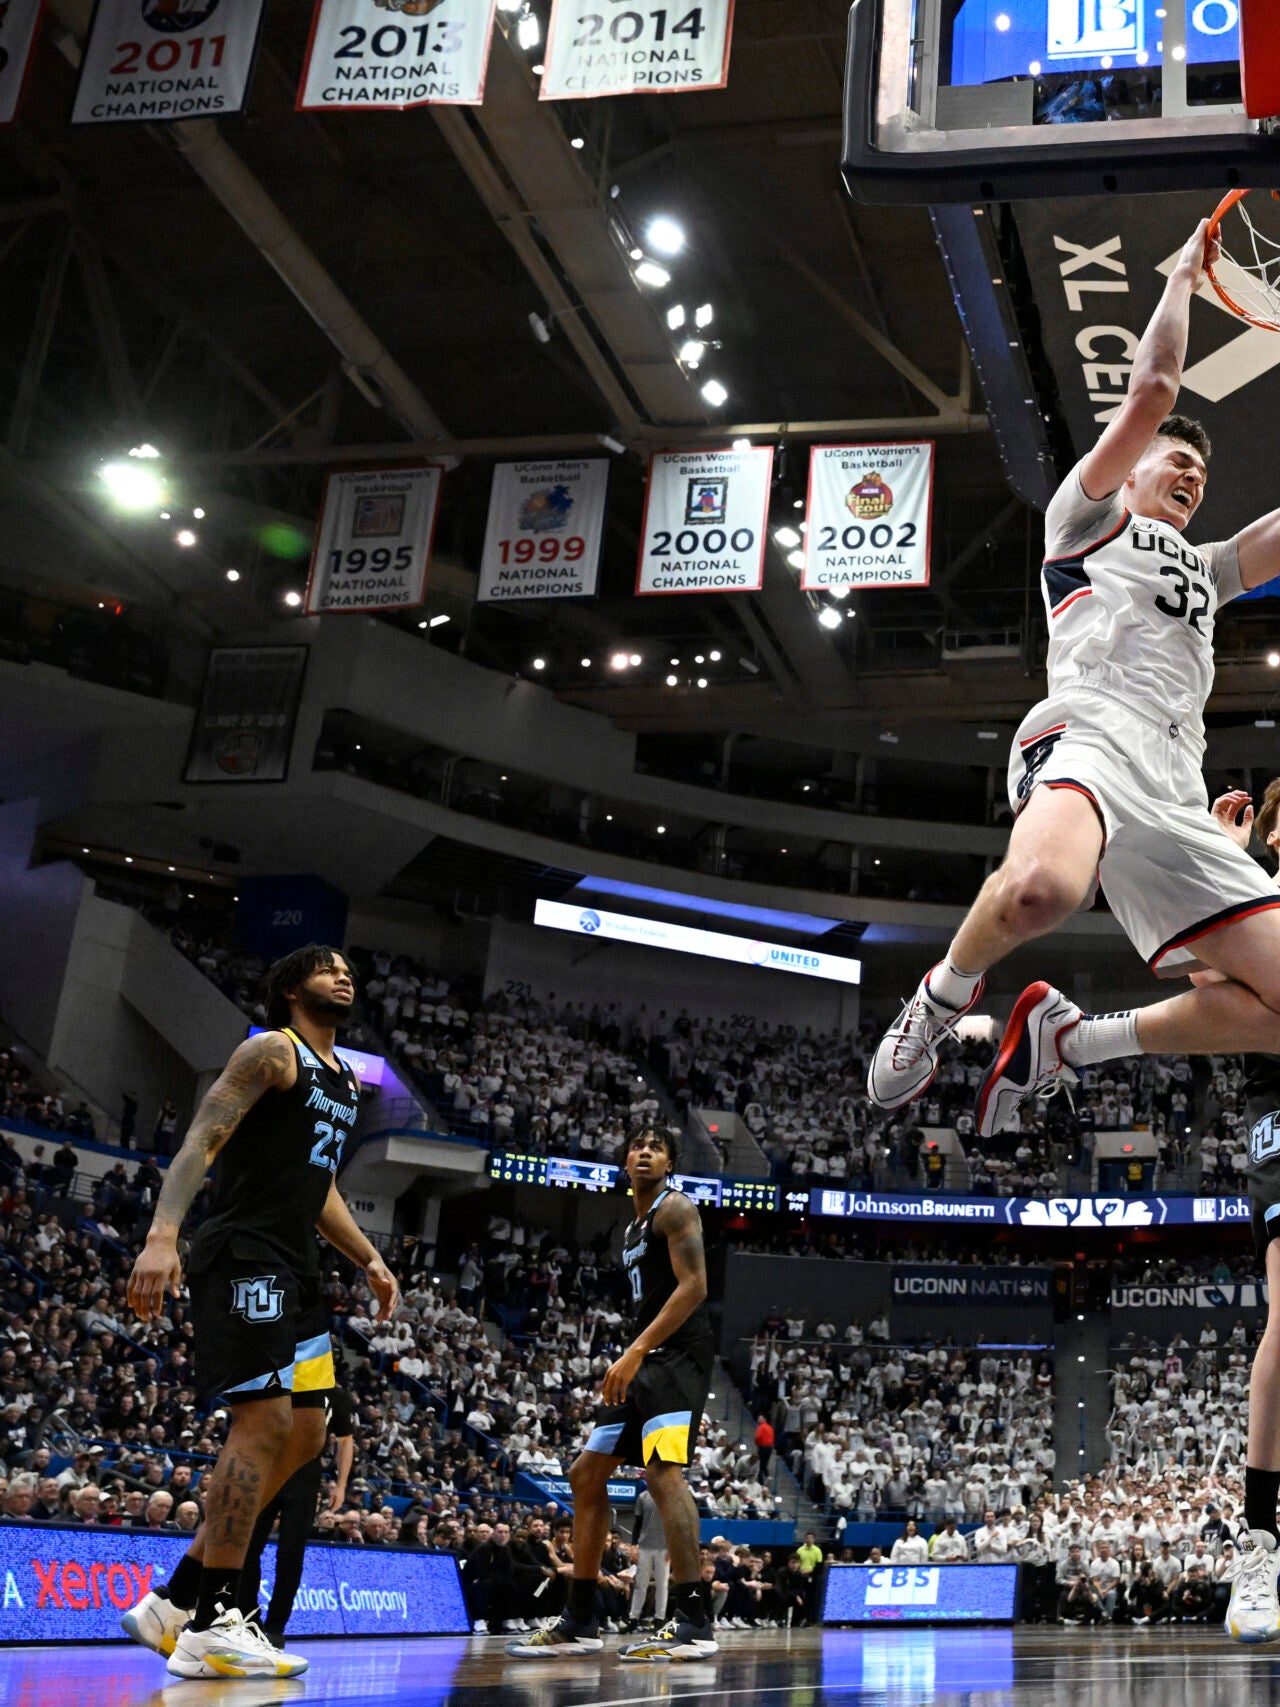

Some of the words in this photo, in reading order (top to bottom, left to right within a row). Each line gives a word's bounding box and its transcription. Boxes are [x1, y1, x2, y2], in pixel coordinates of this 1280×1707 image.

[573, 8, 705, 47] 2014
[333, 22, 466, 59] 2013
[109, 35, 226, 75] 2011
[578, 48, 696, 67] NATIONAL
[335, 62, 452, 80] NATIONAL
[105, 76, 219, 96] NATIONAL
[322, 82, 460, 101] CHAMPIONS
[91, 95, 225, 118] CHAMPIONS
[1053, 235, 1129, 311] XL
[1075, 325, 1137, 422] CEN
[663, 454, 702, 463] UConn
[824, 449, 863, 458] UConn
[867, 446, 921, 457] Women's
[514, 463, 553, 472] UConn
[556, 461, 589, 470] Men's
[680, 465, 741, 475] Basketball
[841, 459, 902, 469] Basketball
[520, 473, 581, 484] Basketball
[846, 493, 885, 505] Final
[650, 528, 754, 556] 2000
[817, 522, 917, 551] 2002
[498, 536, 585, 565] 1999
[330, 546, 414, 574] 1995
[661, 559, 741, 572] NATIONAL
[826, 554, 906, 567] NATIONAL
[499, 567, 578, 581] NATIONAL
[652, 574, 746, 588] CHAMPIONS
[818, 570, 912, 583] CHAMPIONS
[328, 577, 406, 590] NATIONAL
[490, 582, 583, 597] CHAMPIONS
[320, 591, 410, 607] CHAMPIONS
[1155, 566, 1209, 638] 32
[271, 909, 301, 927] 220
[771, 949, 819, 967] UNITED
[506, 980, 531, 998] 221
[309, 1121, 348, 1173] 23
[504, 1171, 512, 1180] 0
[516, 1172, 523, 1181] 0
[538, 1175, 546, 1184] 0
[590, 1168, 609, 1182] 45
[722, 1188, 732, 1197] 10
[355, 1201, 375, 1212] 119
[894, 1278, 967, 1295] UCONN
[971, 1279, 1048, 1297] NATIN
[230, 1275, 284, 1324] MU
[1112, 1288, 1196, 1307] UCONN
[868, 1568, 930, 1588] CBS
[3, 1573, 24, 1608] A
[32, 1560, 154, 1610] xerox
[339, 1582, 408, 1619] Company
